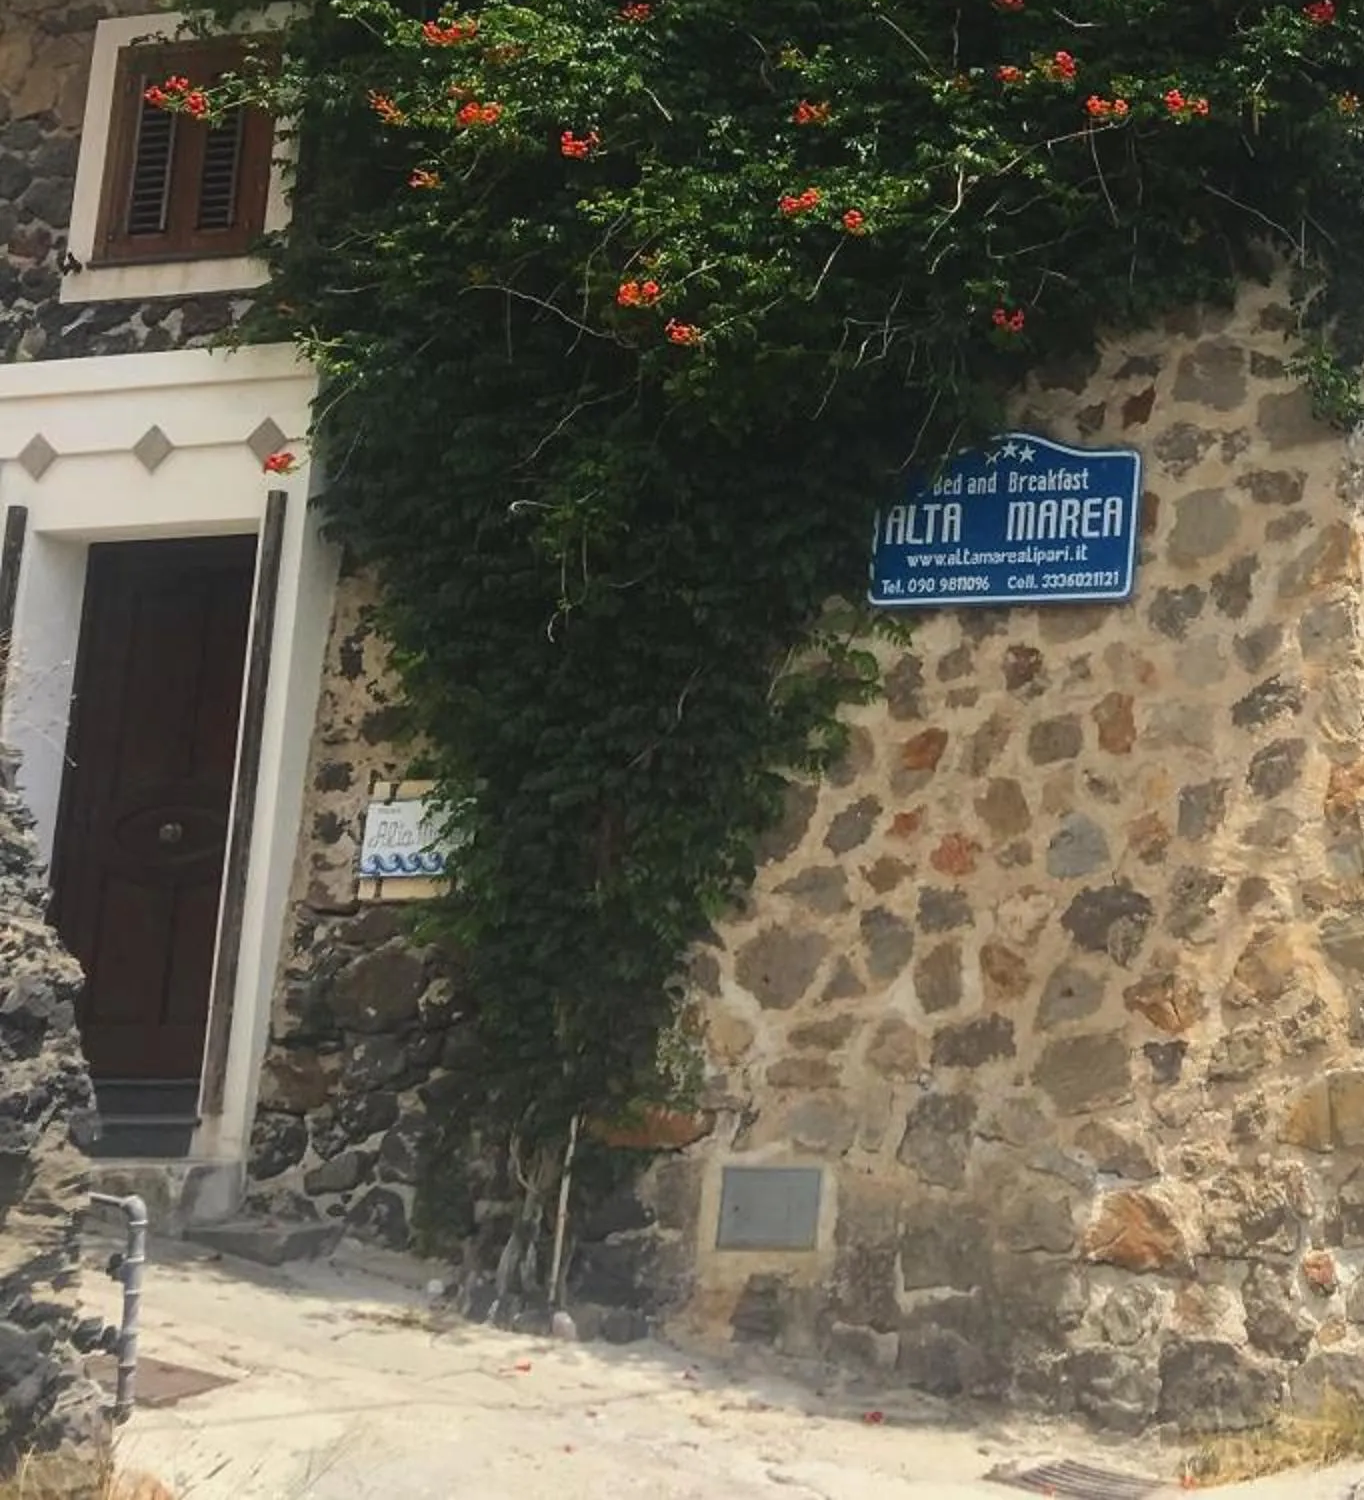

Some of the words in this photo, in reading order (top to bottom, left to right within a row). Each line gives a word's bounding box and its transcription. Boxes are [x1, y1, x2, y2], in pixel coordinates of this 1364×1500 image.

[967, 471, 997, 496] and
[1008, 467, 1089, 493] Breakfast
[885, 502, 963, 545] ALTA
[1005, 496, 1124, 542] MAREA
[906, 543, 1089, 567] www.altamarealipari.it
[881, 579, 904, 595] Tel.
[908, 577, 935, 593] 090
